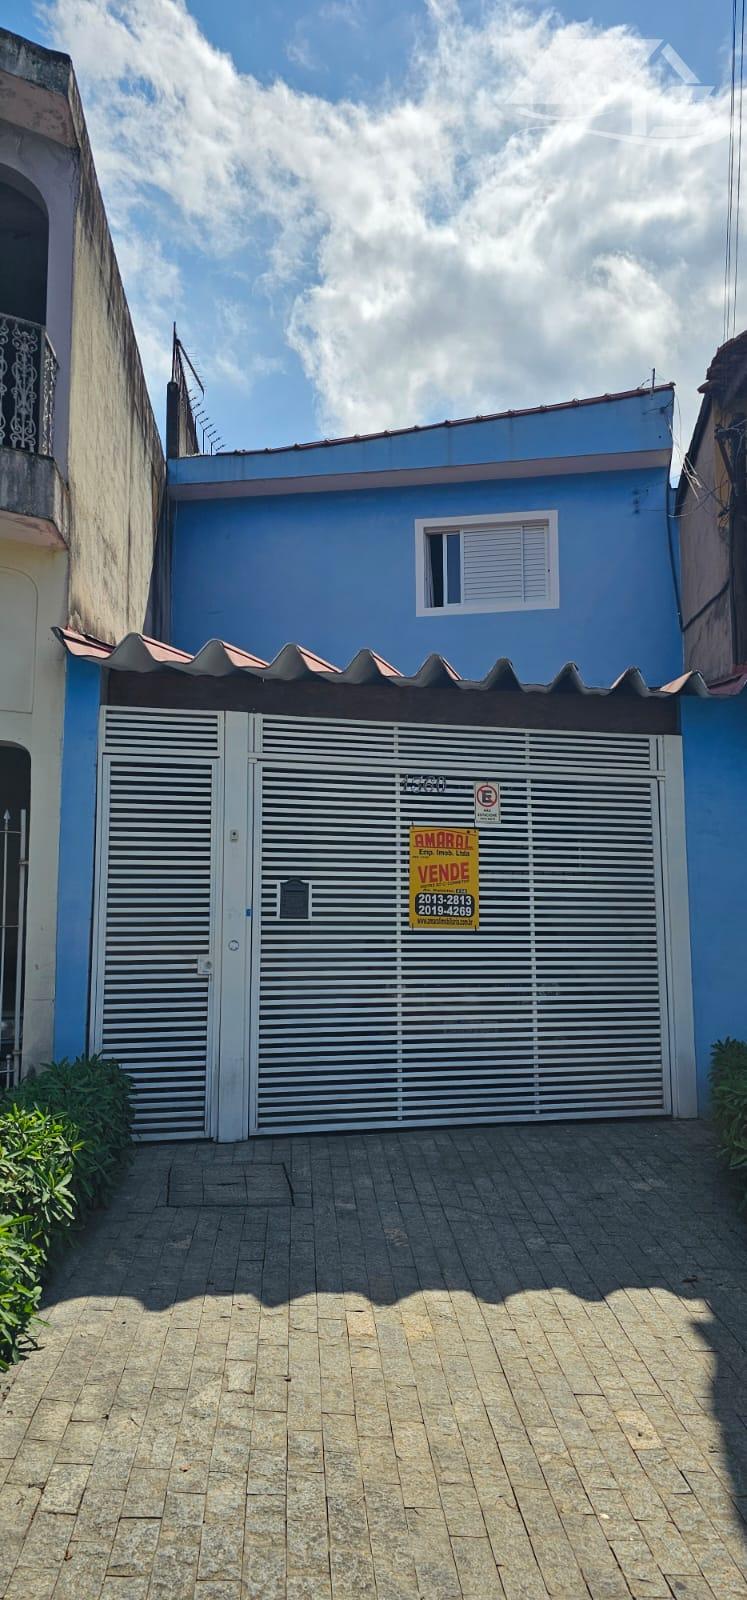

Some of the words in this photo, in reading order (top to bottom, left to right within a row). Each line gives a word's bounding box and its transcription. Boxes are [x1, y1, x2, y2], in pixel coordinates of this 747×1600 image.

[415, 832, 472, 849] AMARAL
[418, 861, 469, 883] VENDE
[418, 894, 472, 905] 2013-2813
[418, 905, 472, 916] 2019-4269
